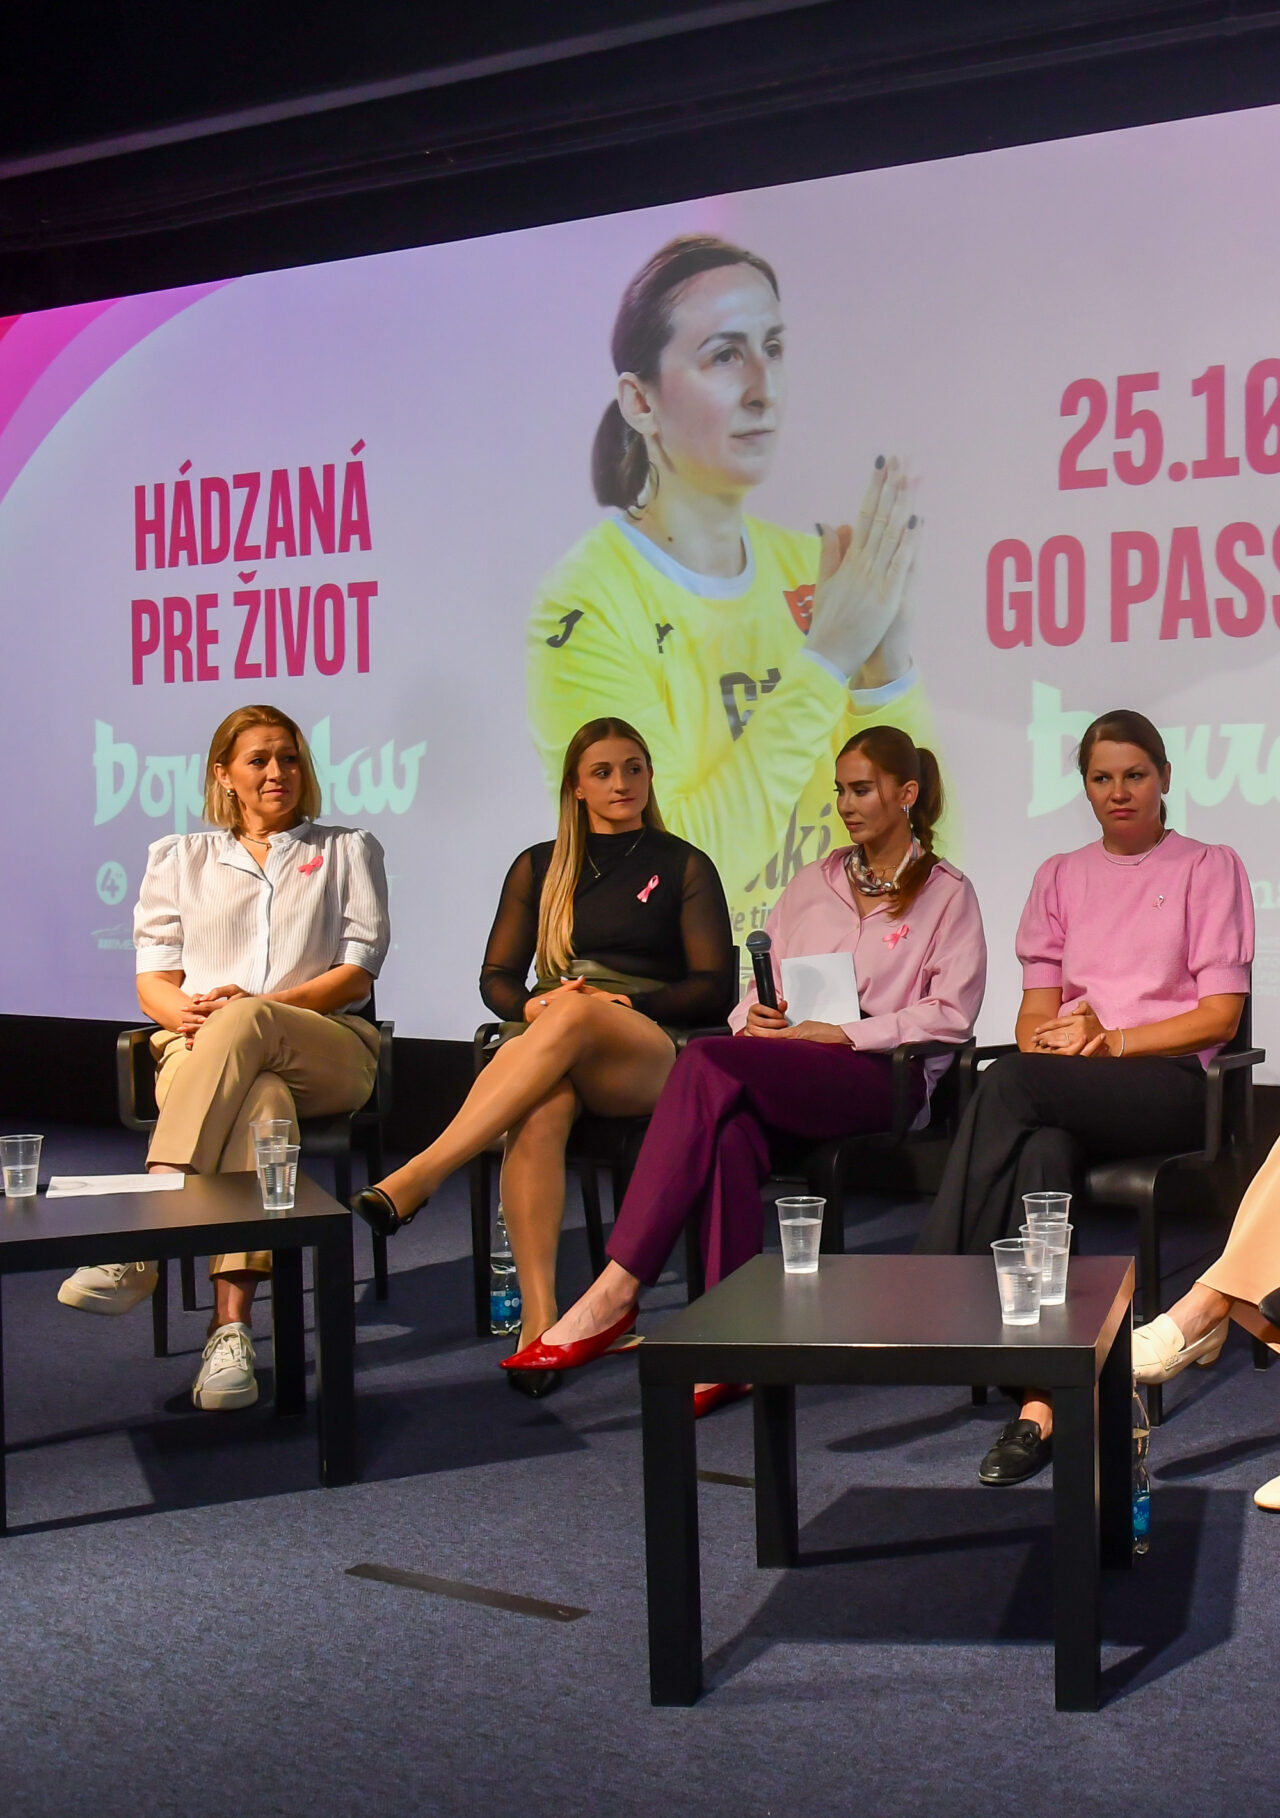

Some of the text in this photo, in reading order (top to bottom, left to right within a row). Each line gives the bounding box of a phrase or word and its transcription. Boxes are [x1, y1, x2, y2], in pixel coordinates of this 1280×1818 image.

[134, 438, 373, 571] HÁDZANÁ
[131, 569, 379, 685] PRE ŽIVOT
[986, 534, 1087, 650] GO
